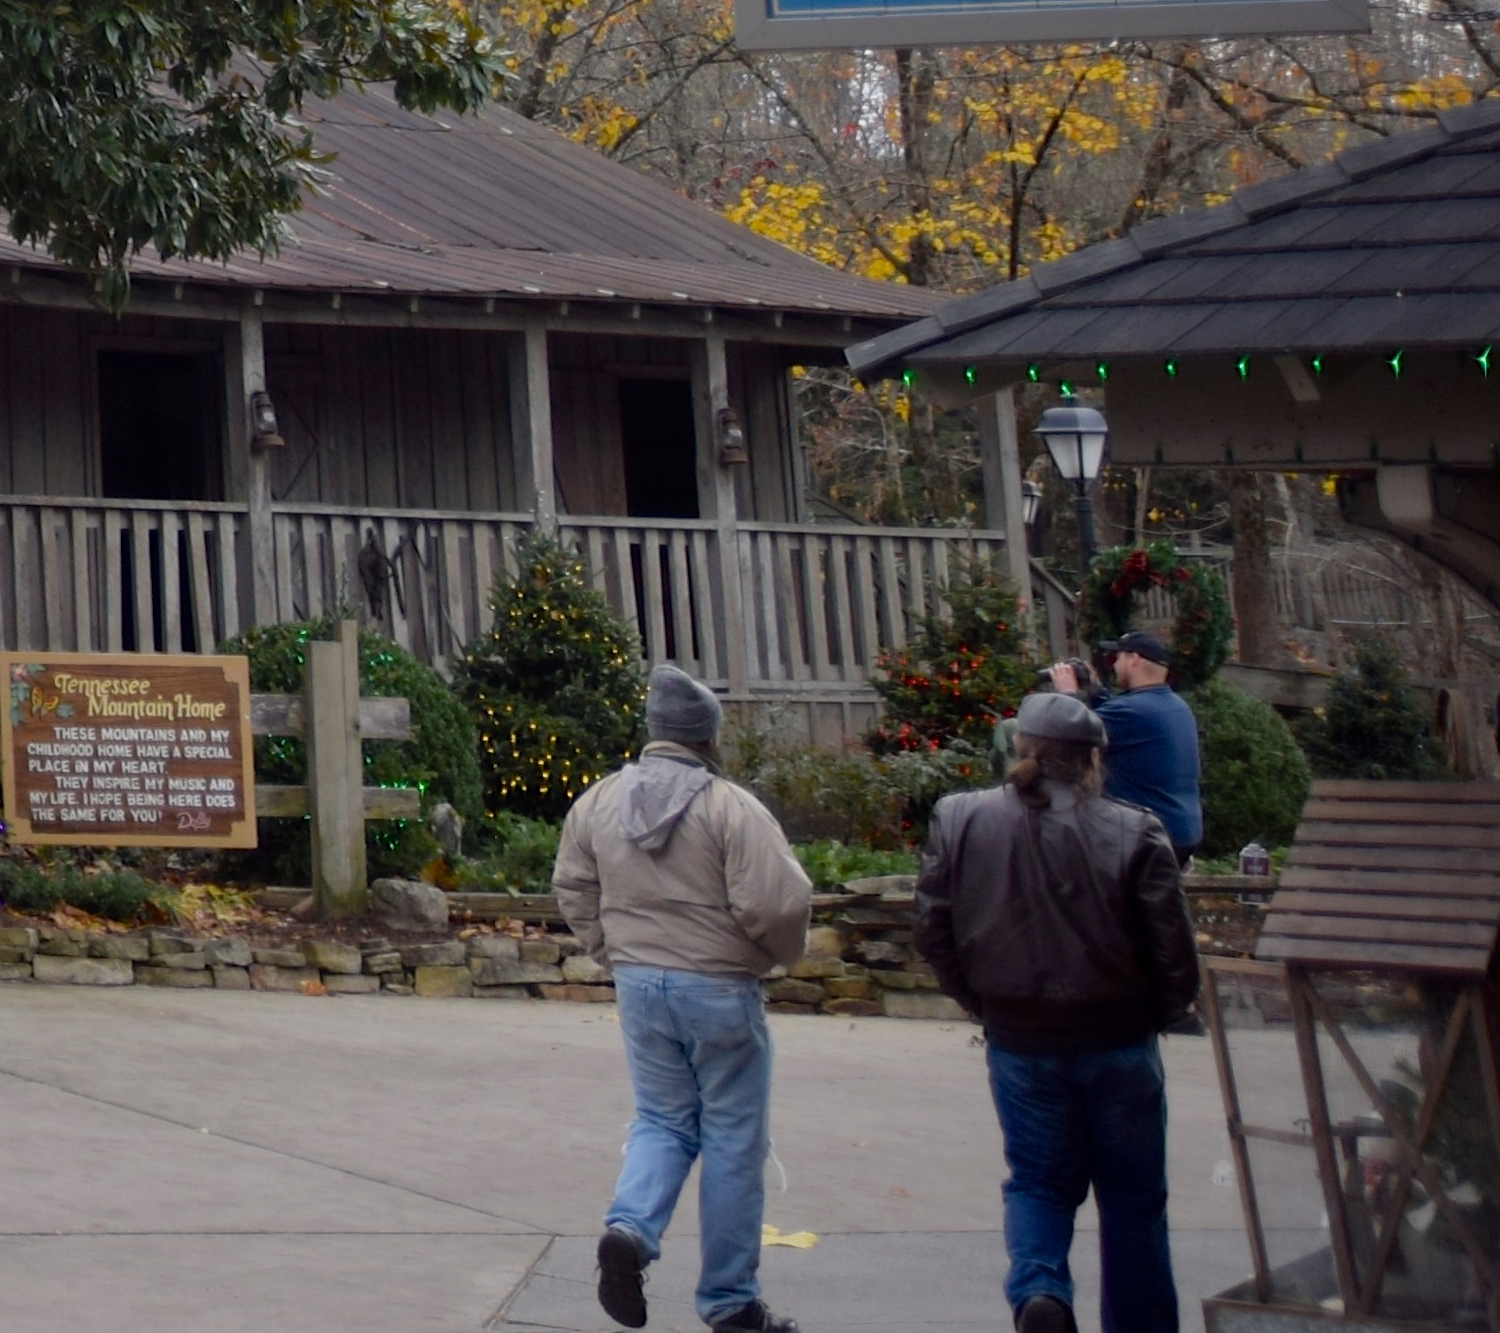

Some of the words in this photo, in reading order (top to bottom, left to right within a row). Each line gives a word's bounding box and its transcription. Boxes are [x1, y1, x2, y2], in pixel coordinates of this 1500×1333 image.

[54, 673, 151, 696] Tennessee
[87, 693, 174, 720] Mountain
[173, 693, 226, 721] Home
[54, 726, 96, 740] THESE
[101, 727, 176, 742] MOUNTAINS
[180, 729, 206, 741] AND
[210, 730, 230, 742] MY
[27, 743, 94, 756] CHILDHOOD
[97, 744, 132, 757] HOME
[136, 745, 169, 758] HAVE
[172, 746, 182, 758] A
[184, 745, 232, 759] SPECIAL
[28, 759, 70, 773] PLACE
[93, 760, 115, 773] MY
[121, 760, 169, 774] HEART.
[55, 776, 89, 789] THEY
[93, 776, 141, 790] INSPIRE
[145, 778, 165, 790] MY
[168, 778, 207, 791] MUSIC
[209, 779, 235, 791] AND
[29, 791, 48, 805] MY
[50, 791, 79, 805] LIFE.
[83, 792, 88, 805] I
[90, 793, 122, 805] HOPE
[127, 793, 165, 806] BEING
[168, 794, 203, 807] HERE
[206, 795, 236, 808] DOES
[32, 808, 56, 821] THE
[60, 808, 96, 822] SAME
[100, 809, 125, 822] FOR
[130, 809, 163, 822] YOU!
[175, 811, 212, 830] Dolly
